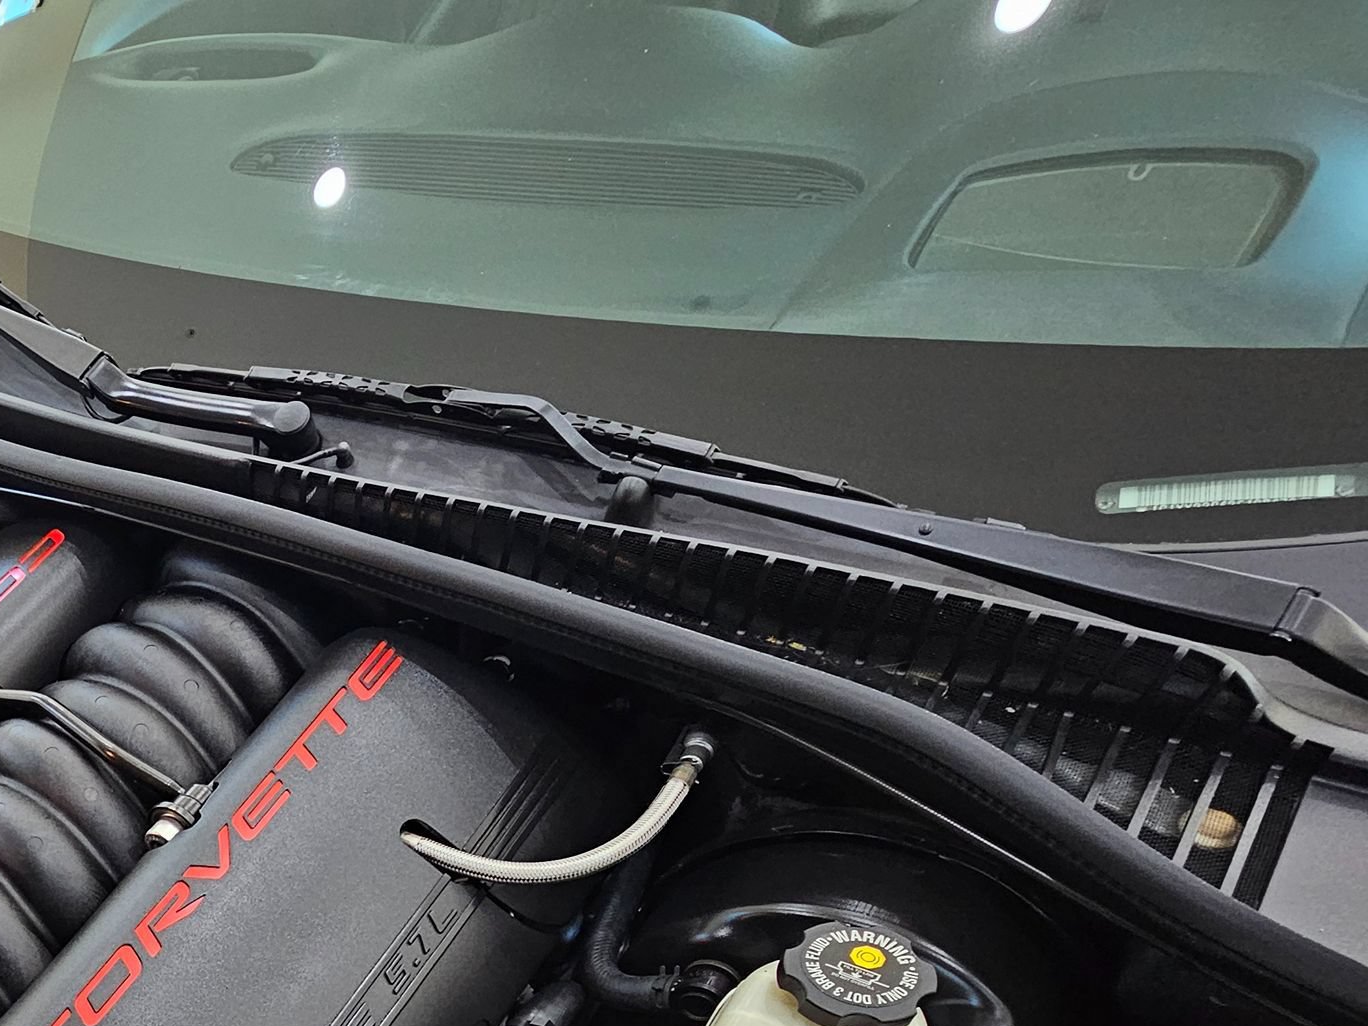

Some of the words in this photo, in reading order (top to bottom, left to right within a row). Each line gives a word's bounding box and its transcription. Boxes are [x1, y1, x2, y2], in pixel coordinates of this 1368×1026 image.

[384, 908, 458, 995] 5.7L
[805, 936, 831, 961] FLUID
[831, 929, 917, 965] WARNING
[806, 961, 835, 991] BRAKE
[899, 970, 919, 990] USE
[833, 986, 844, 997] 3
[844, 991, 872, 1005] DOT
[877, 986, 909, 1005] ONLY
